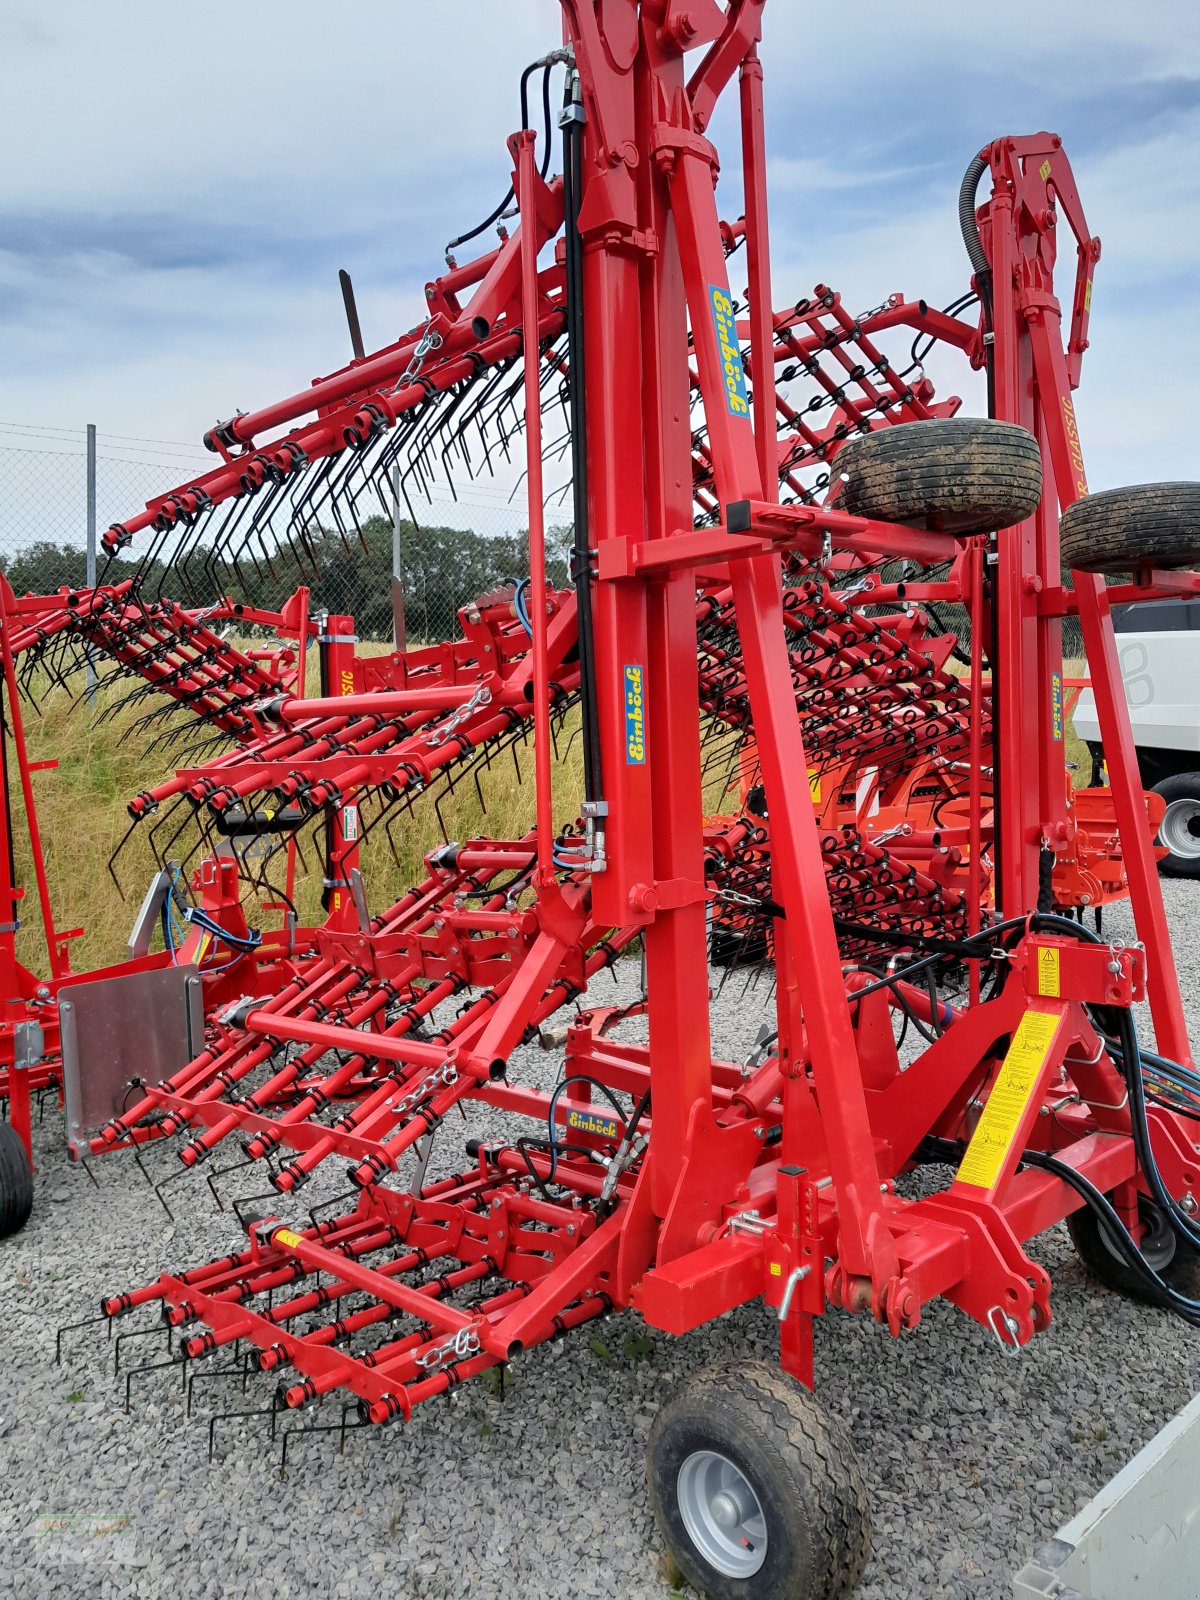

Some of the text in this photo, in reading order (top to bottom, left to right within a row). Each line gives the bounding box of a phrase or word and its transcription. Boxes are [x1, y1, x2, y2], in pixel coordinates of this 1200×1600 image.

[713, 290, 748, 414] Einböck
[626, 667, 644, 761] Einböck
[569, 1111, 616, 1137] Einböck
